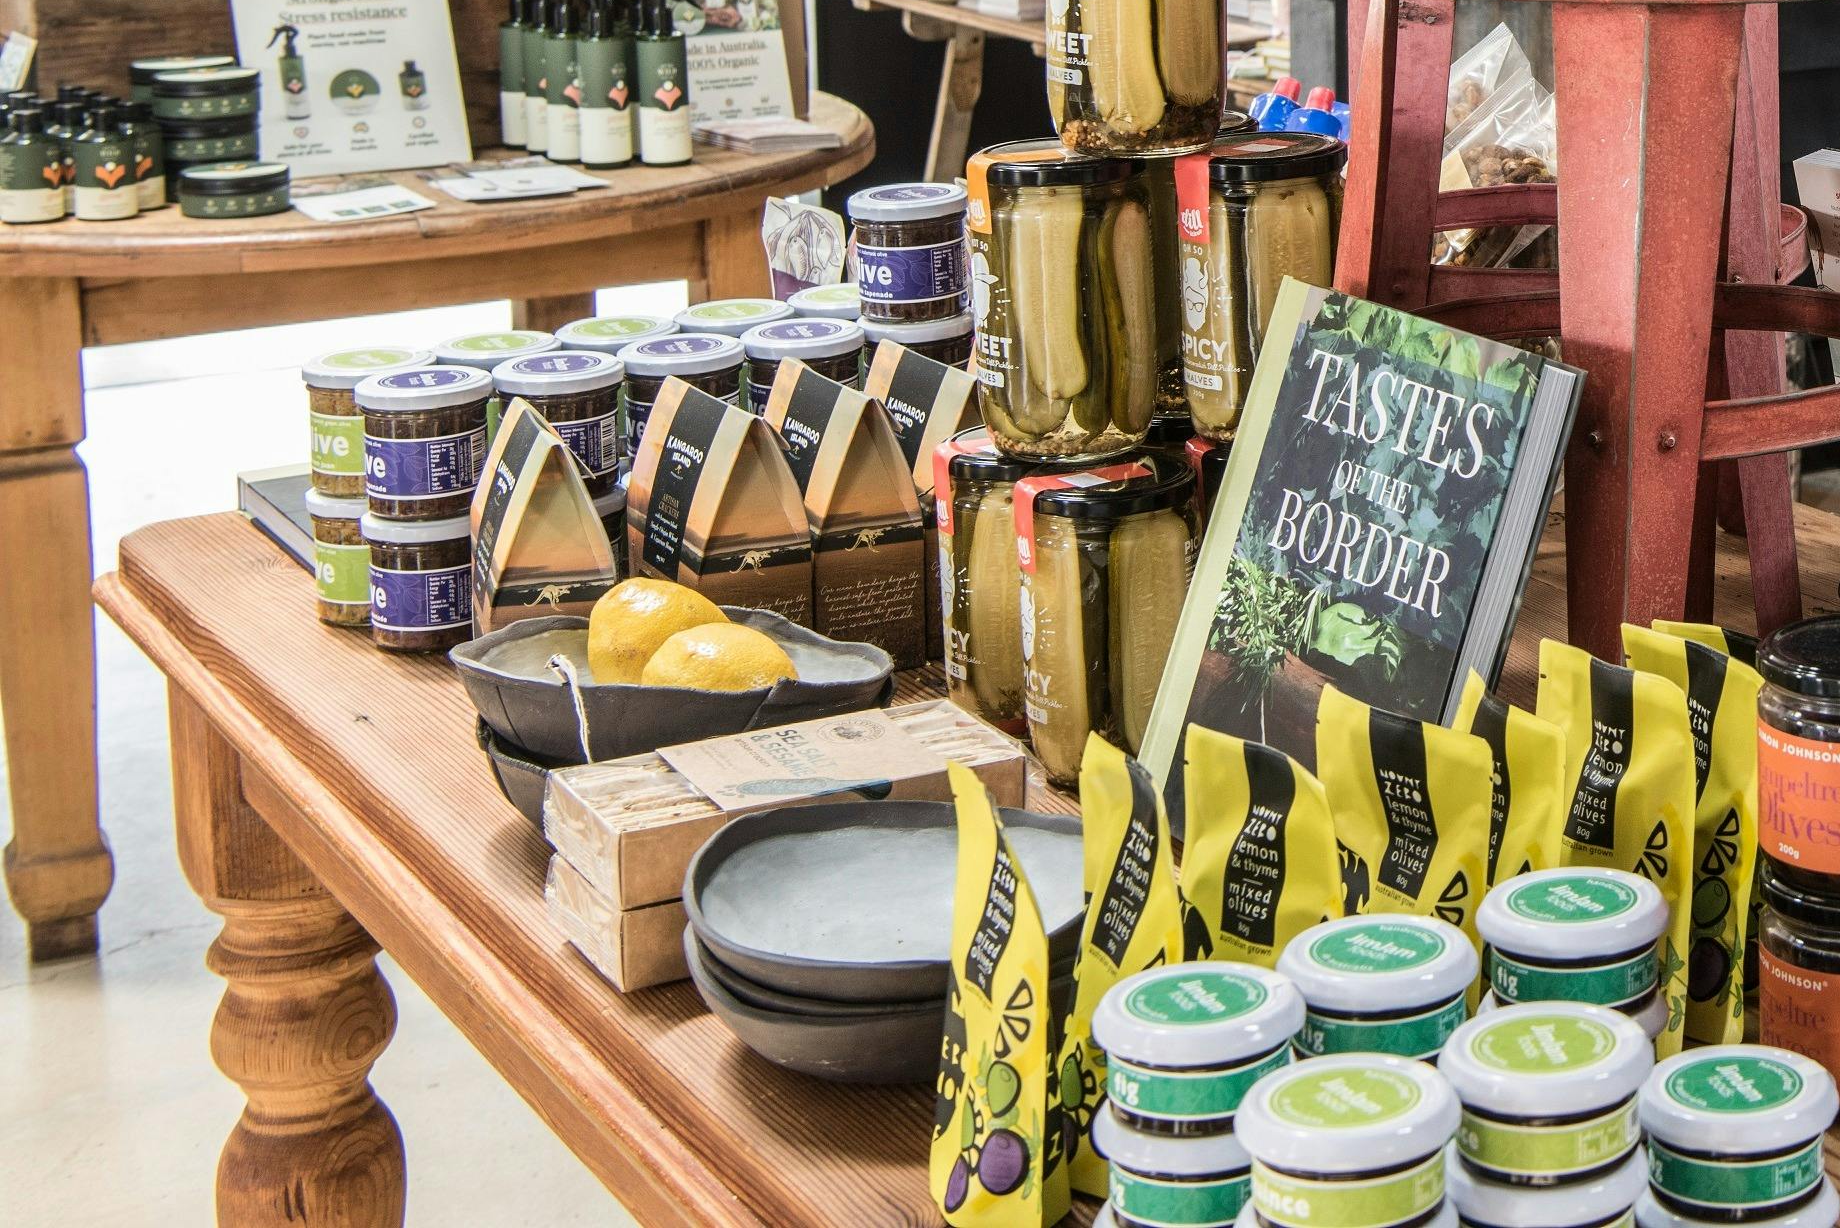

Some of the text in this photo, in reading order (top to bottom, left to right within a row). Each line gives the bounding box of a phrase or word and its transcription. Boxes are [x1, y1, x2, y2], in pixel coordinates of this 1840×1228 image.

[278, 5, 408, 24] Stress resistance
[688, 42, 703, 54] ade
[720, 39, 767, 53] Australia.
[718, 55, 759, 69] Organic
[1193, 245, 1203, 256] SO
[1181, 330, 1228, 362] SPICY
[887, 395, 926, 424] KANGAROO
[894, 411, 913, 428] ISLAND
[1301, 347, 1496, 480] TASTES
[784, 416, 820, 445] KANGAROO
[790, 432, 808, 449] ISLAND
[666, 434, 704, 464] KANGAROO
[671, 451, 691, 469] ISLAND
[1333, 459, 1412, 515] OF THE
[1267, 487, 1451, 620] BORDER
[776, 729, 838, 768] SEA SALT
[1595, 732, 1623, 755] ZERO
[1589, 747, 1623, 775] lemon
[1582, 765, 1615, 788] & thyme
[1384, 780, 1422, 804] ZERO
[1577, 789, 1608, 810] mixed
[1386, 795, 1428, 822] lemon
[1573, 803, 1606, 825] olives
[1242, 818, 1277, 842] ZERO
[1391, 812, 1432, 837] & thyme
[1576, 825, 1591, 839] 80g
[1235, 834, 1279, 863] lemon
[1394, 835, 1429, 859] mixed
[1778, 842, 1800, 860] 200g
[1120, 849, 1150, 885] lemon
[1231, 853, 1279, 880] & thyme
[1391, 850, 1424, 874] olives
[1115, 869, 1146, 903] & thyme
[1228, 881, 1273, 905] mixed
[1396, 873, 1408, 889] 80g
[1227, 897, 1268, 921] olives
[1548, 882, 1605, 914] JimJam
[1108, 897, 1137, 927] mixed
[1103, 912, 1132, 942] olives
[1247, 944, 1272, 958] grown
[1345, 932, 1418, 961] JimJam
